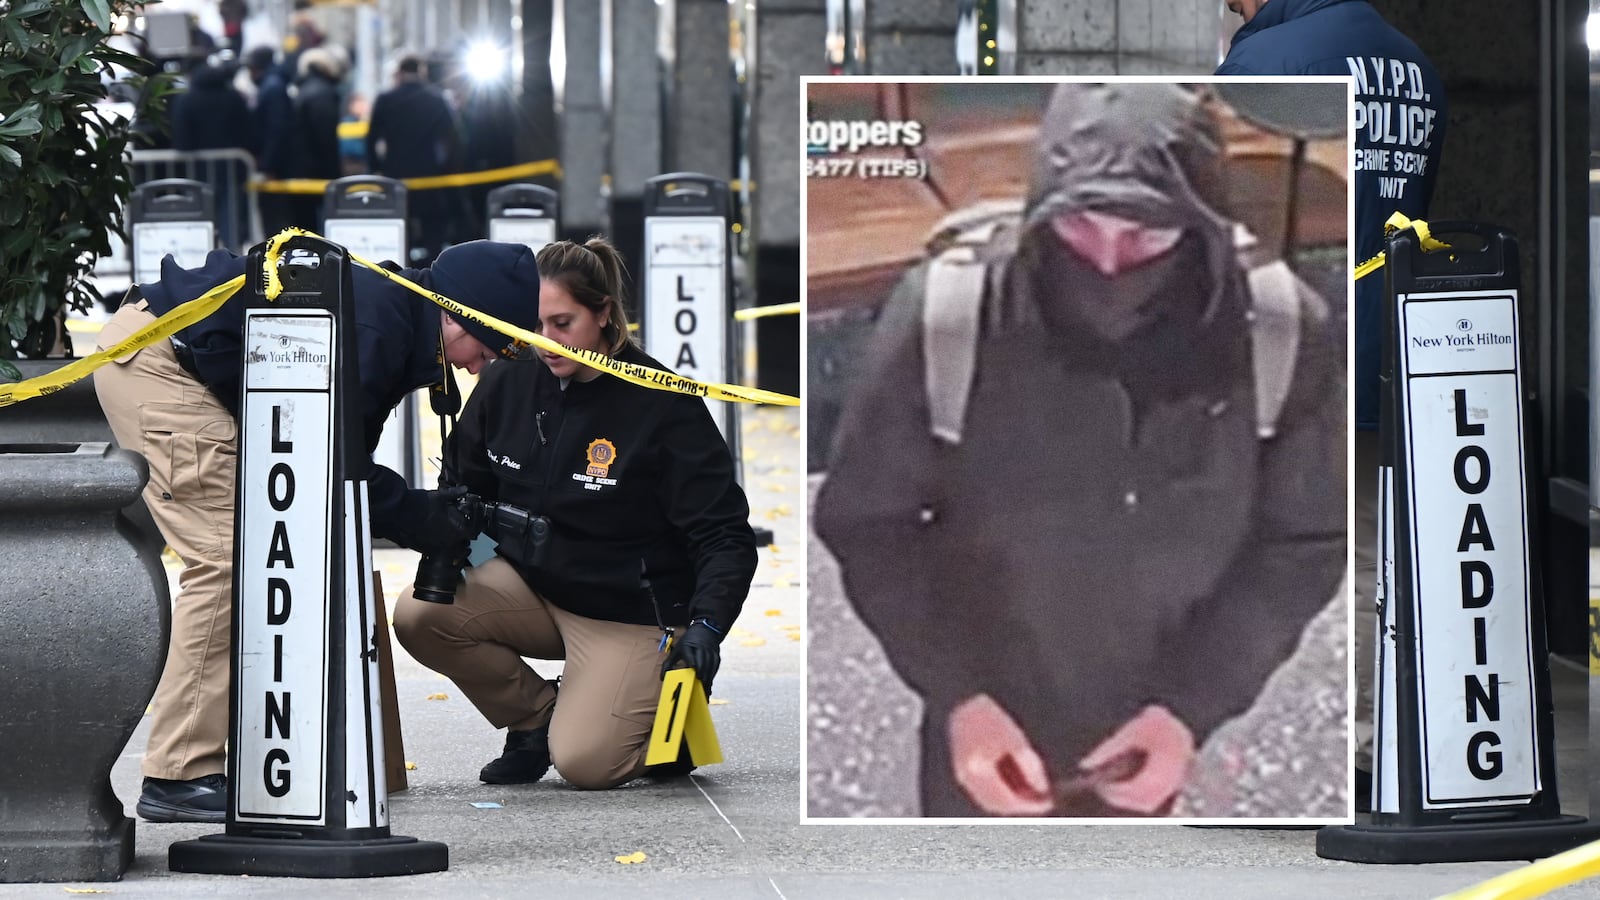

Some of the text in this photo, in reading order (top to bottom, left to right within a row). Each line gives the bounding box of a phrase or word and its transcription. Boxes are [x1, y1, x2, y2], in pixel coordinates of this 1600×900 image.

[1346, 57, 1430, 102] N.Y.P.D.
[1355, 101, 1436, 149] POLICE
[1355, 149, 1390, 171] CRIME
[250, 350, 327, 363] New York Hilton
[1413, 333, 1512, 348] New York Hilton
[572, 473, 618, 486] CRIME SCENE
[584, 482, 602, 491] UNIT
[1453, 388, 1504, 781] LOADING
[263, 405, 296, 798] LOADING
[664, 681, 684, 743] 1
